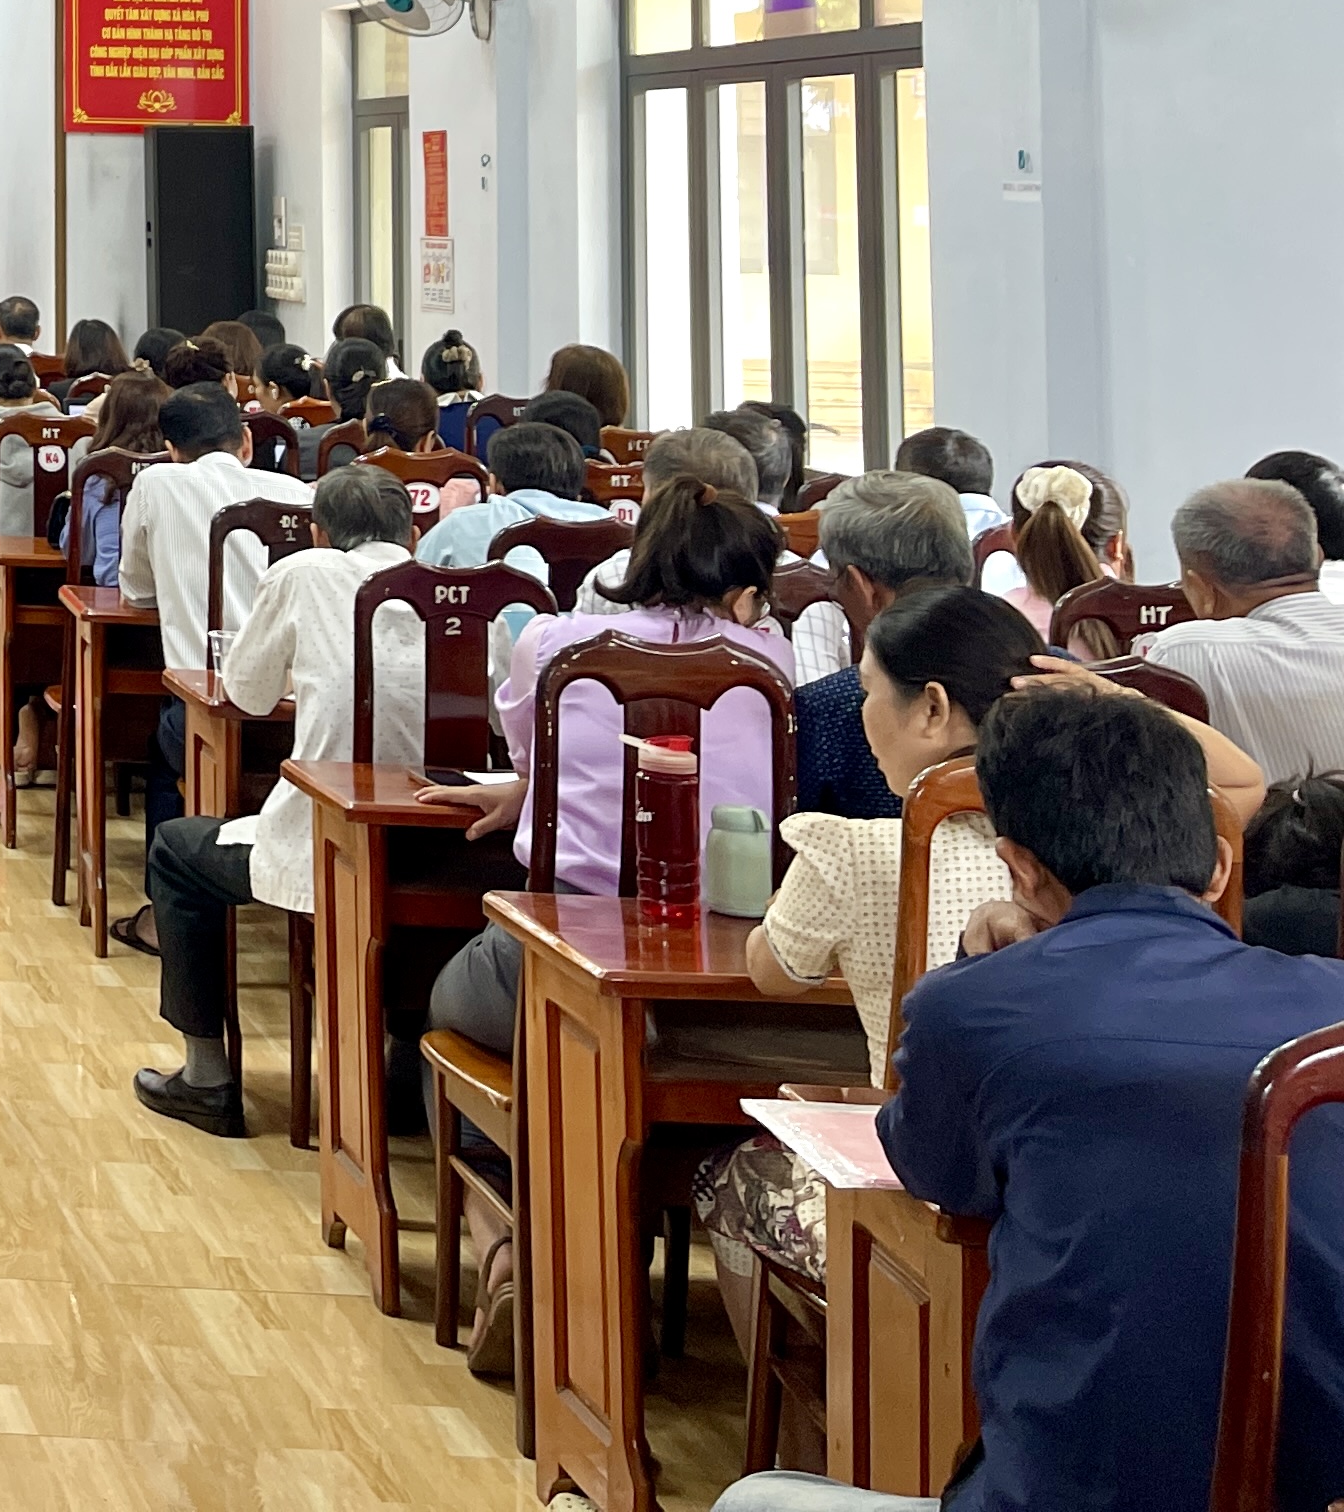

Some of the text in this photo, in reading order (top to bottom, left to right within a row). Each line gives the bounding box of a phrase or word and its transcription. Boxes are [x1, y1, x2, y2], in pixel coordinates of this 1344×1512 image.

[43, 428, 59, 438] HT
[610, 475, 631, 486] HT
[434, 585, 470, 604] PCT
[1140, 606, 1174, 625] HT
[445, 618, 461, 635] 2
